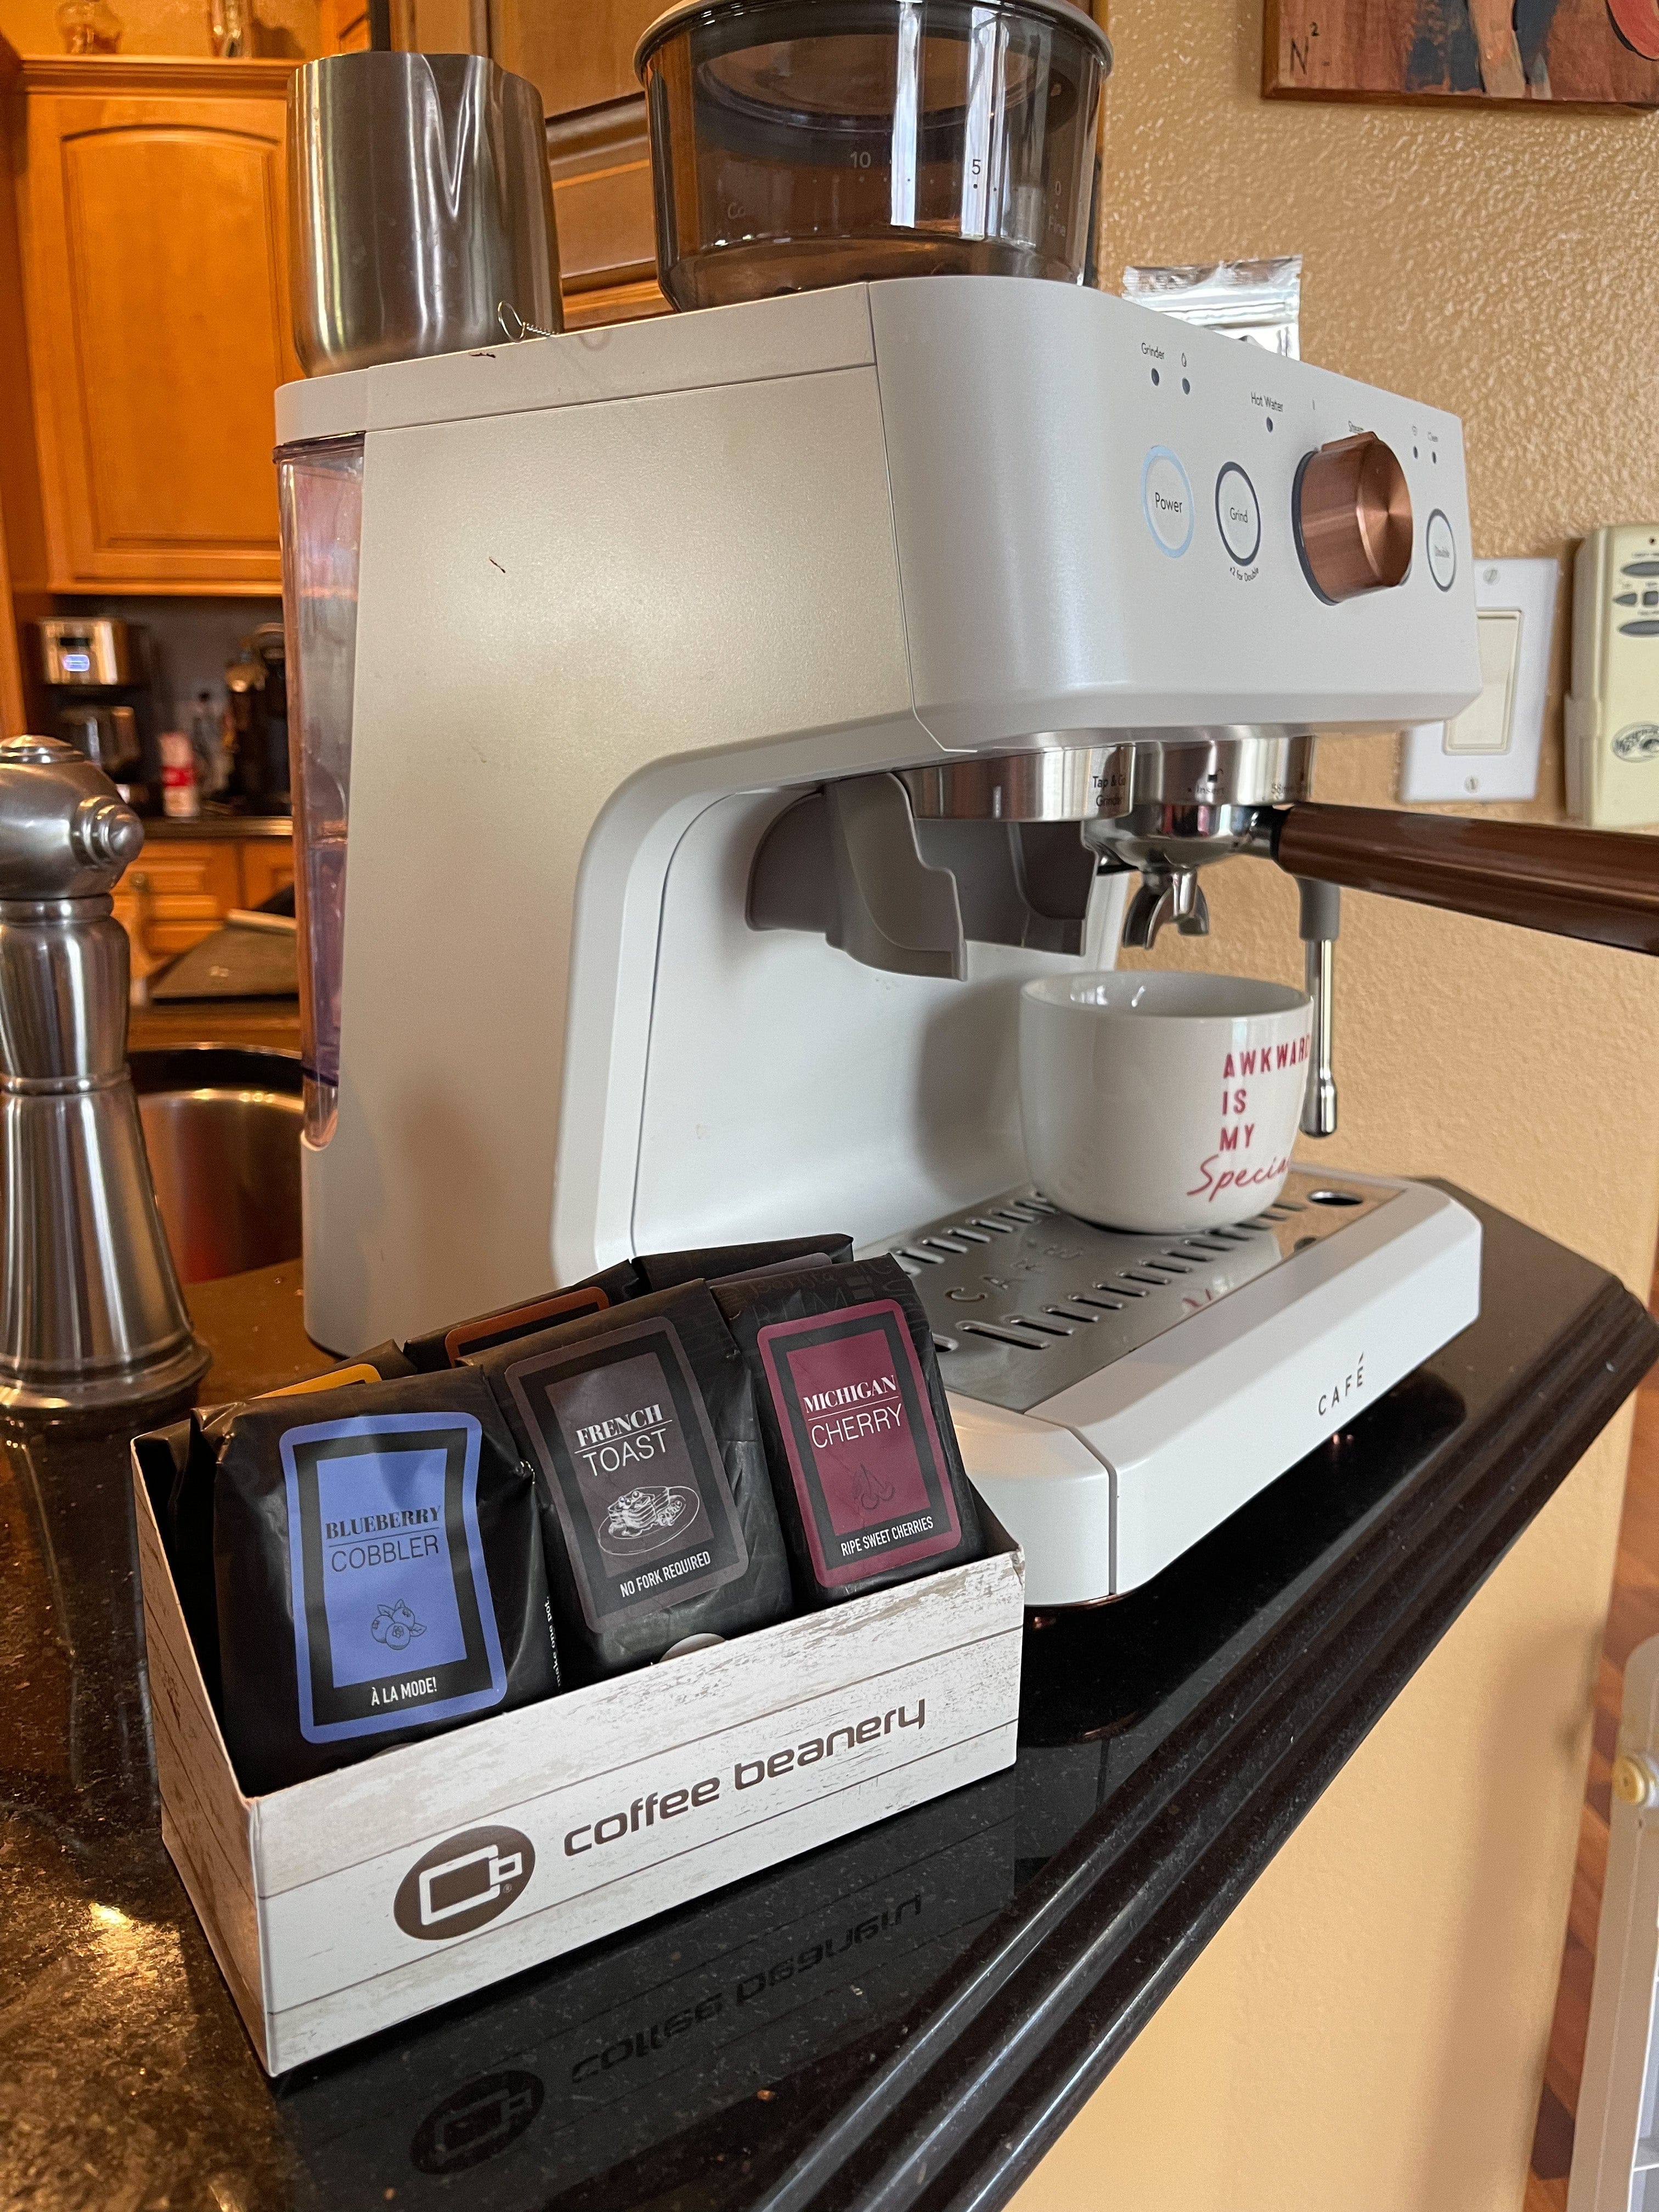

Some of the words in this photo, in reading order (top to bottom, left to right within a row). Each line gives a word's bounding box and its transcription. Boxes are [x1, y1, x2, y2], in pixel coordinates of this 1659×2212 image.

[850, 151, 871, 168] 10
[972, 159, 981, 174] 5
[1141, 342, 1165, 360] Grinder
[1250, 391, 1263, 407] Hot
[1263, 395, 1283, 413] Water
[1155, 492, 1182, 513] Power
[1230, 507, 1248, 523] Grind
[1092, 776, 1108, 791] Tap
[1111, 775, 1116, 787] &
[1222, 1088, 1247, 1116] IS
[1220, 1124, 1255, 1152] MY
[1187, 1154, 1290, 1202] Specia
[803, 1375, 898, 1414] MICHIGAN
[1318, 1352, 1364, 1416] CAFÉ
[575, 1404, 664, 1447] FRENCH
[811, 1403, 902, 1448] CHERRY
[583, 1428, 667, 1477] TOAST
[325, 1505, 441, 1539] BLUEBERRY
[840, 1536, 862, 1556] RIPE
[862, 1528, 890, 1550] SWEET
[891, 1516, 934, 1541] CHERRIES
[332, 1534, 439, 1572] COBBLER
[619, 1581, 635, 1598] NO
[636, 1570, 663, 1593] FORK
[663, 1551, 712, 1583] REQUIRED
[371, 1686, 380, 1706] À
[383, 1684, 399, 1703] LA
[401, 1677, 438, 1701] MODE!
[564, 1777, 720, 1857] coffee
[734, 1698, 926, 1791] beanery
